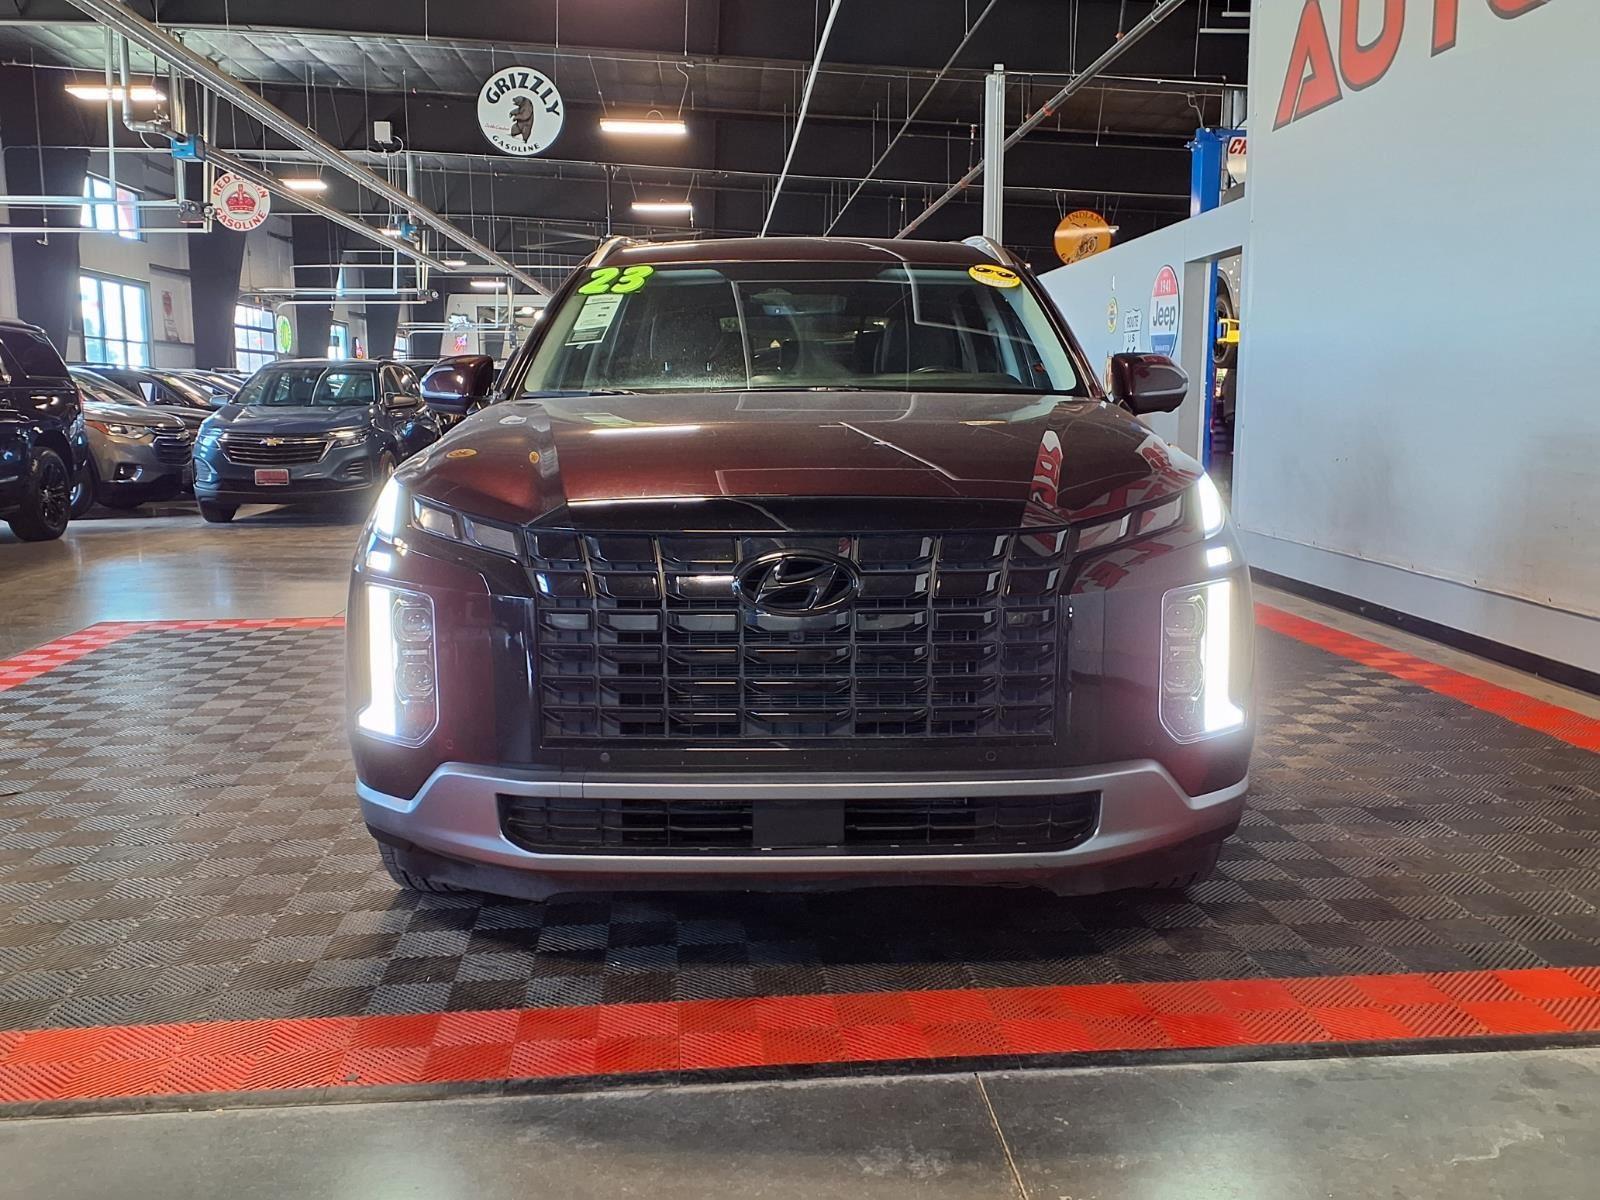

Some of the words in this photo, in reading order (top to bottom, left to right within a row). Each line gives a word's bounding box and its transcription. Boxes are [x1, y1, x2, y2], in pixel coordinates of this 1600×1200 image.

[1272, 0, 1548, 132] AU
[486, 72, 560, 116] GRIZZLY
[492, 135, 540, 153] GASOLINE
[213, 175, 231, 196] RED
[216, 207, 266, 230] GASOLINE
[1068, 211, 1102, 224] INDIAN
[578, 265, 654, 294] 23
[1152, 301, 1176, 332] Jeep
